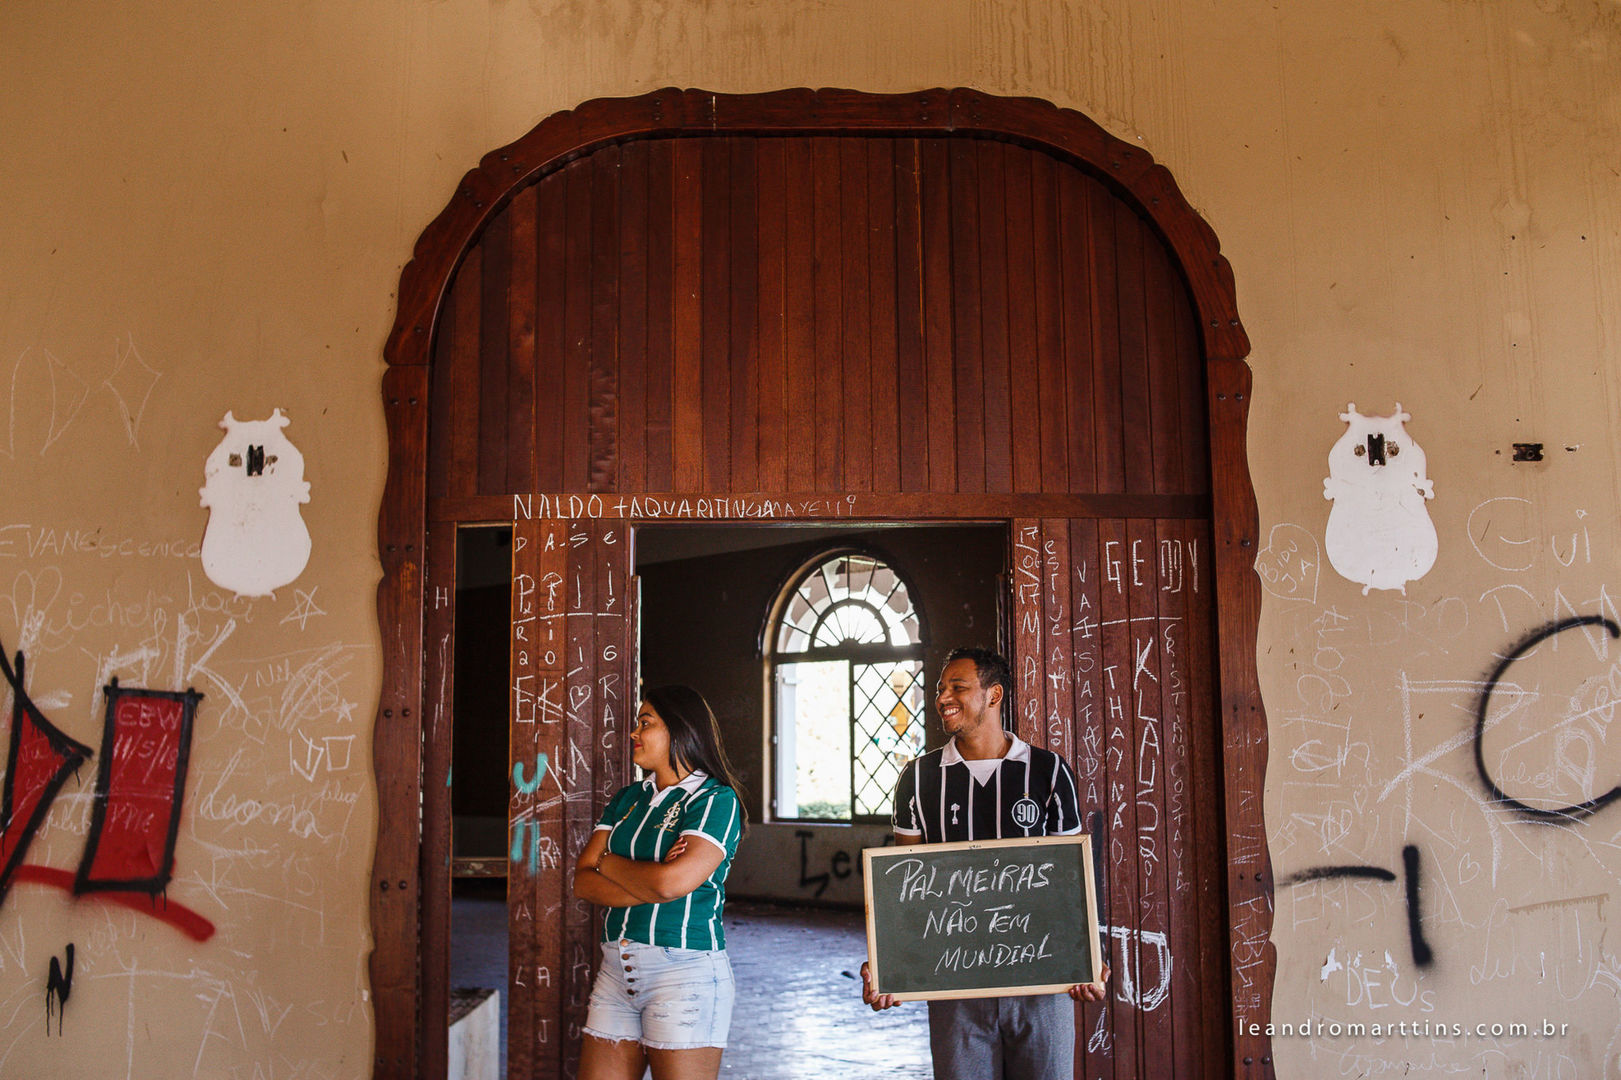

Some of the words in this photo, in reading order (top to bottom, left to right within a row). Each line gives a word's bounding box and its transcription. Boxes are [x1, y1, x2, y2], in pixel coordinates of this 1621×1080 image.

[1016, 803, 1037, 824] 90
[923, 900, 978, 940] NÃO
[984, 904, 1031, 934] TEM
[934, 933, 1052, 976] MUNDIAL
